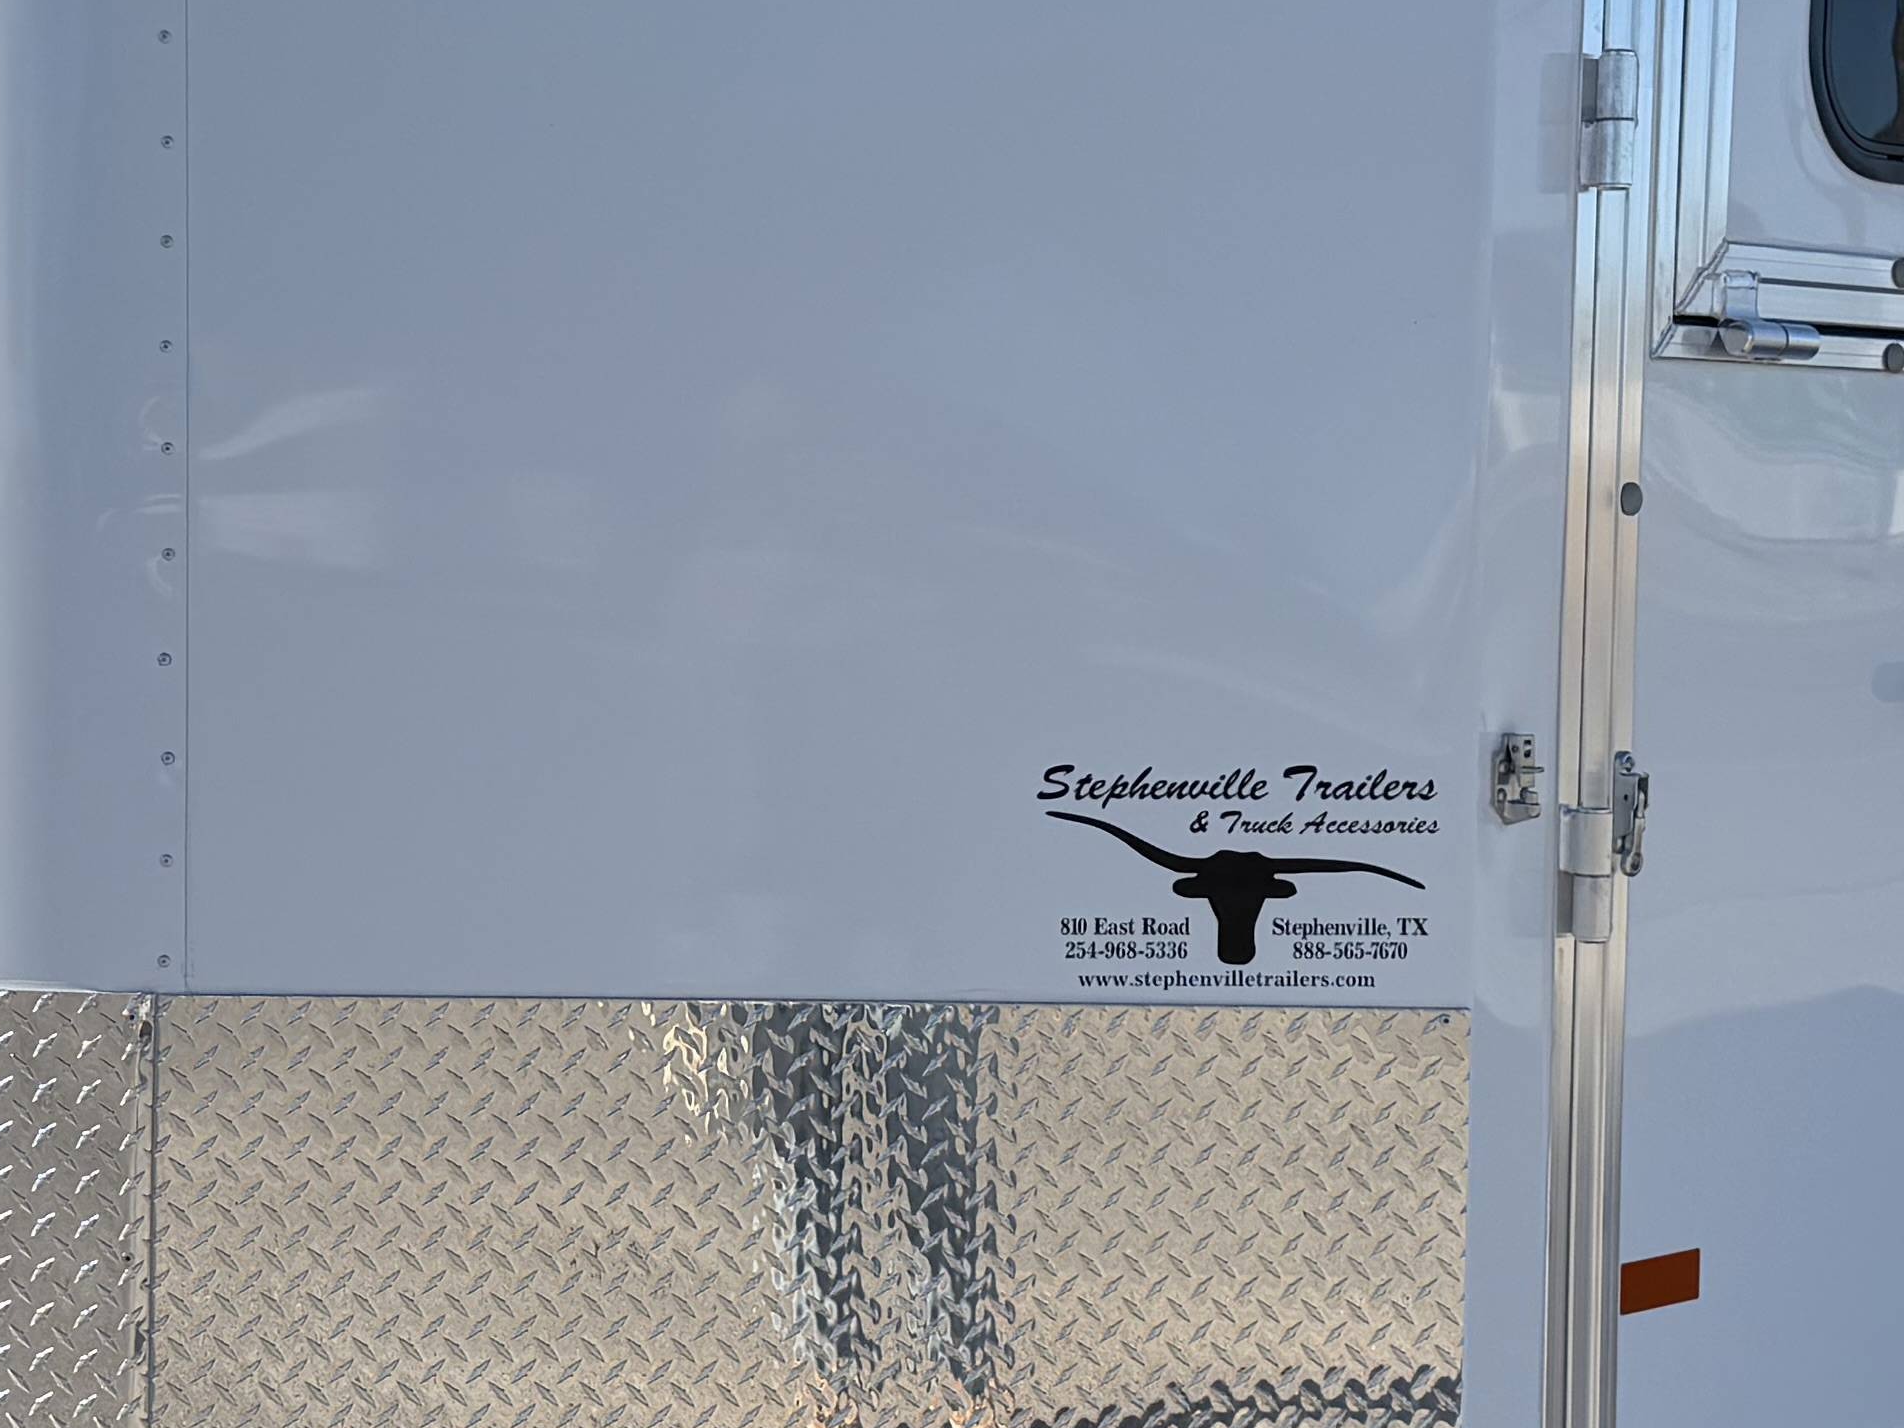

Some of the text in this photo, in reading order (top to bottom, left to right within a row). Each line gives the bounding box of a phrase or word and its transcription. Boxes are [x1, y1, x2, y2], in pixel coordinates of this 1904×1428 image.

[1036, 764, 1438, 809] Stephenville Trailers
[1189, 810, 1440, 834] & Truck Accessories
[1060, 917, 1190, 936] 810 East Road
[1272, 917, 1429, 940] Stephenville, TX
[1065, 941, 1188, 960] 254-968-5336
[1292, 941, 1408, 960] 888-565-7670
[1078, 970, 1376, 991] www.stephenvilletrailers.com
